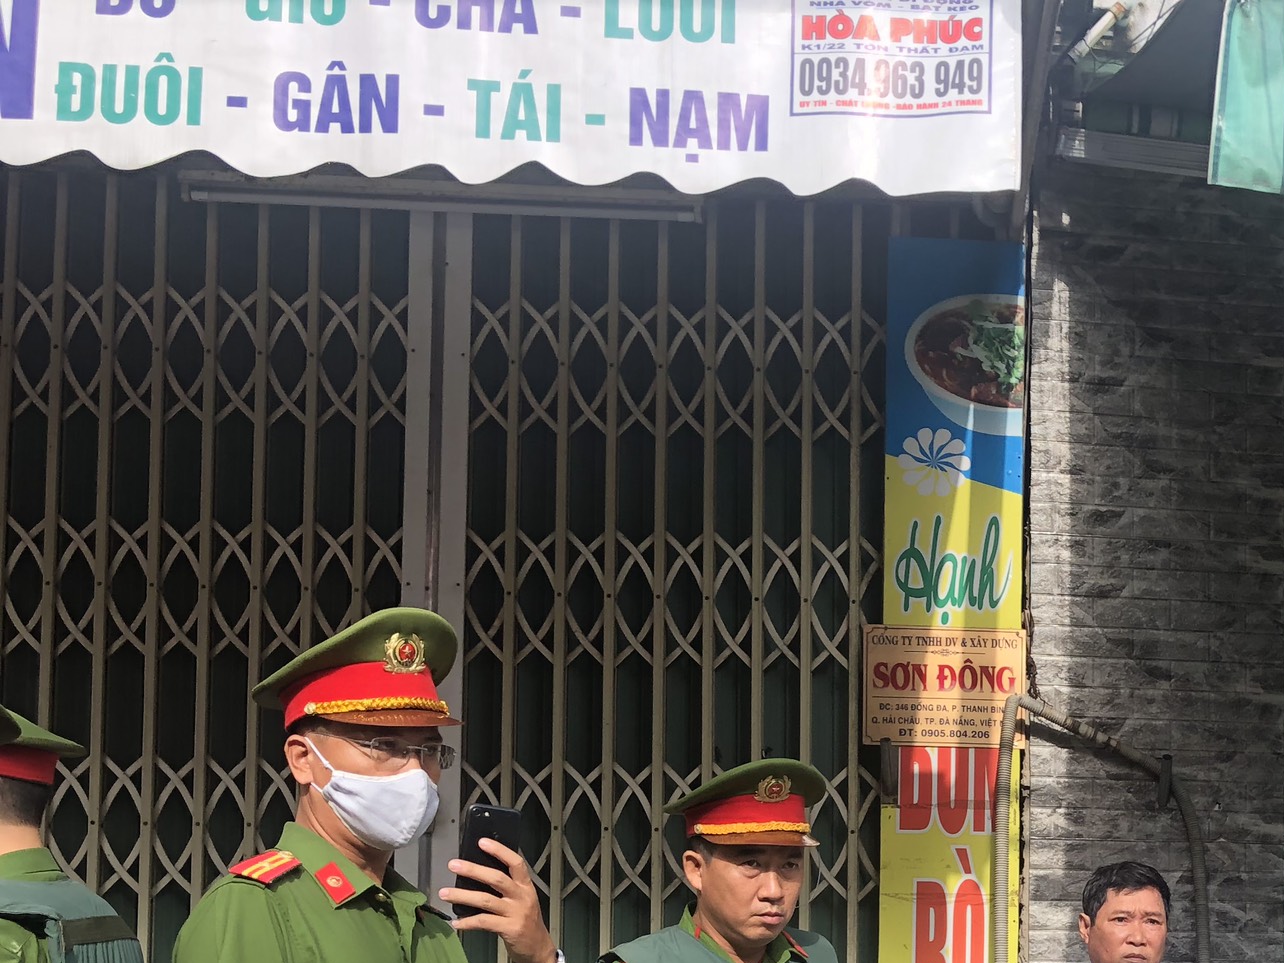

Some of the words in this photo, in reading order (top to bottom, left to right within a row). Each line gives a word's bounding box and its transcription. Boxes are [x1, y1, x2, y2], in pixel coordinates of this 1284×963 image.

[801, 9, 880, 41] HÒA
[890, 15, 983, 44] PHÚC
[935, 58, 983, 98] 949
[54, 52, 204, 126] ĐUÔI
[273, 60, 400, 134] GÂN
[467, 69, 562, 143] TÁI
[628, 87, 770, 163] NẠM
[896, 514, 1010, 625] Hạnh
[871, 634, 899, 646] CÔNG
[901, 636, 913, 646] TY
[915, 636, 942, 647] TNHH
[945, 637, 959, 647] DV
[961, 638, 967, 647] &
[969, 635, 989, 648] XÂY
[872, 661, 928, 692] SƠN
[936, 658, 1016, 694] ĐÔNG
[871, 716, 881, 725] Q.
[882, 715, 896, 724] HẢI
[939, 716, 950, 726] ĐÀ
[979, 717, 997, 728] VIỆT
[879, 702, 894, 711] ĐC:
[895, 702, 909, 711] 346
[961, 705, 989, 713] THANH
[990, 704, 1005, 714] BÌN
[899, 728, 918, 737] ĐT:
[921, 729, 990, 739] 0905.804.206
